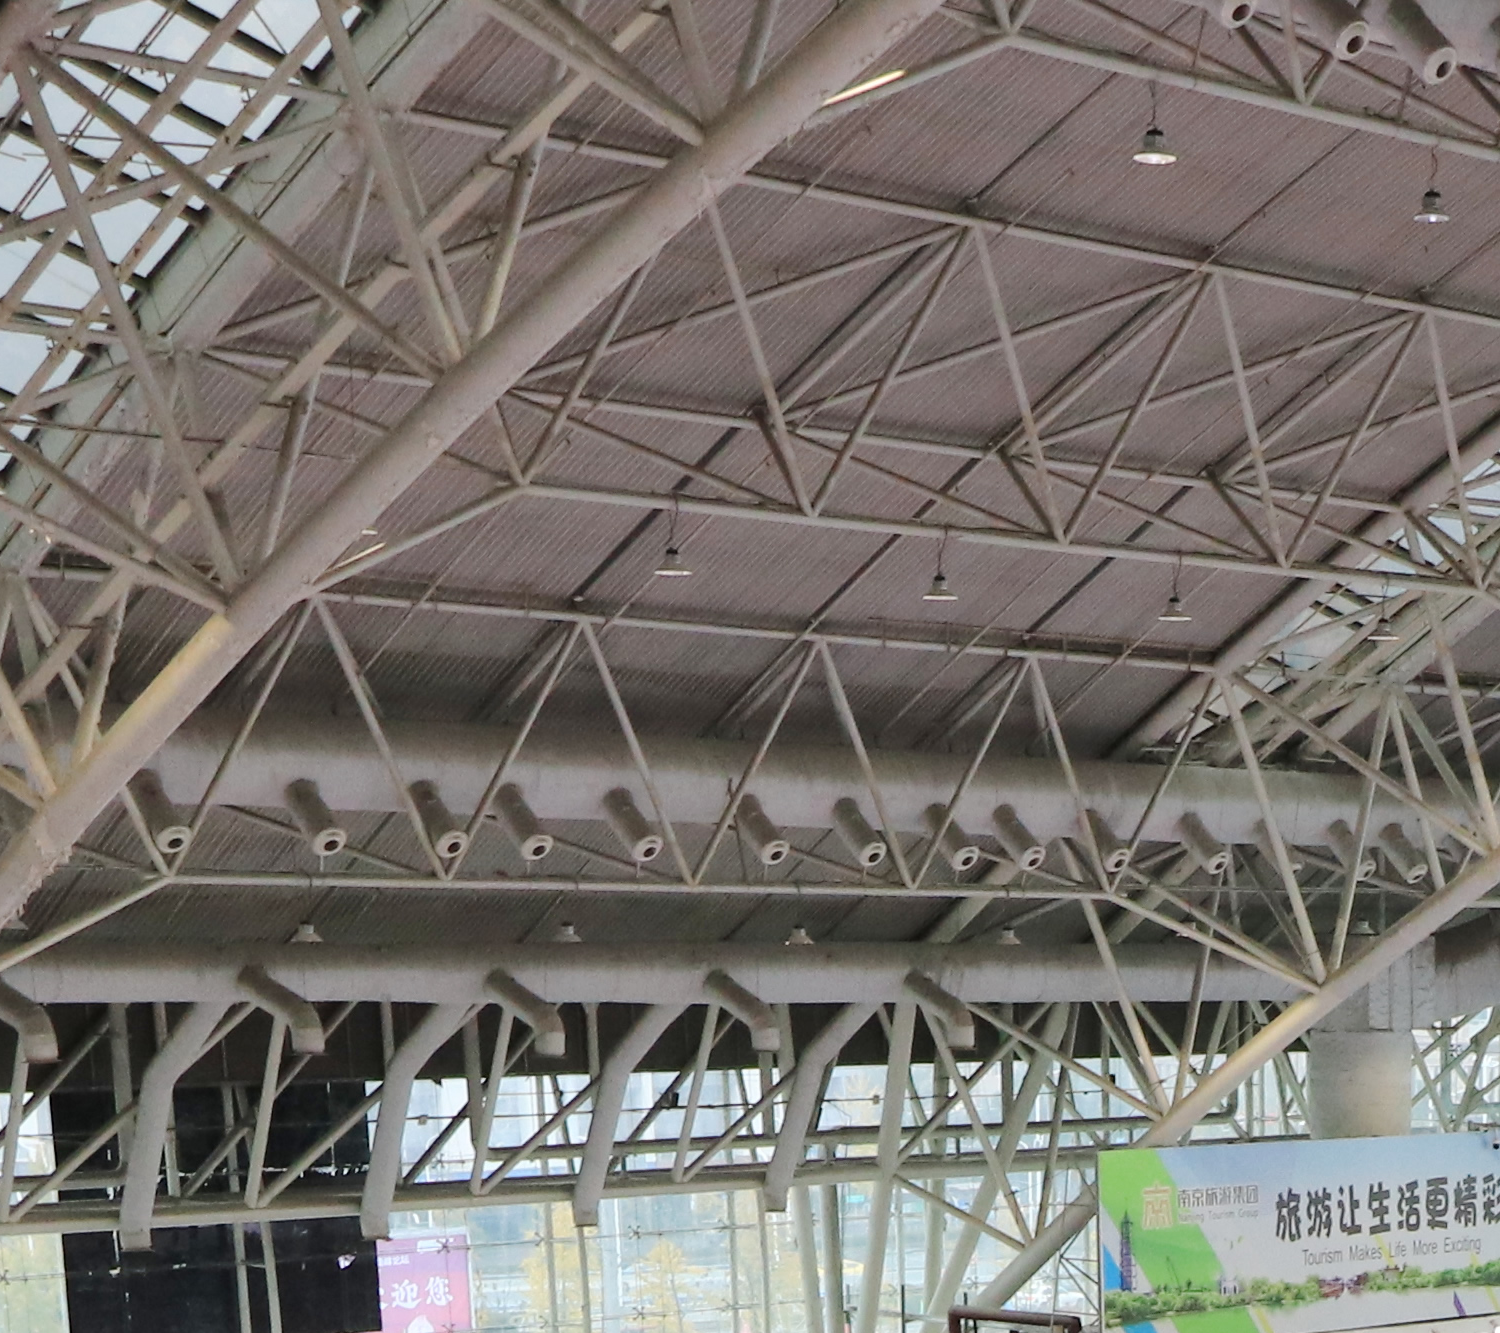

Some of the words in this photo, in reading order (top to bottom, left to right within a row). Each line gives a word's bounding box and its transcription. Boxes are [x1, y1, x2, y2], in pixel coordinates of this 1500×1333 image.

[1177, 1183, 1259, 1208] 南京旅游集团
[1302, 1248, 1344, 1266] Tourism
[1349, 1244, 1383, 1262] Makes
[1389, 1240, 1407, 1258] Life
[1412, 1238, 1439, 1256] More
[1444, 1236, 1481, 1256] Exciting
[379, 1276, 454, 1310] 迎您
